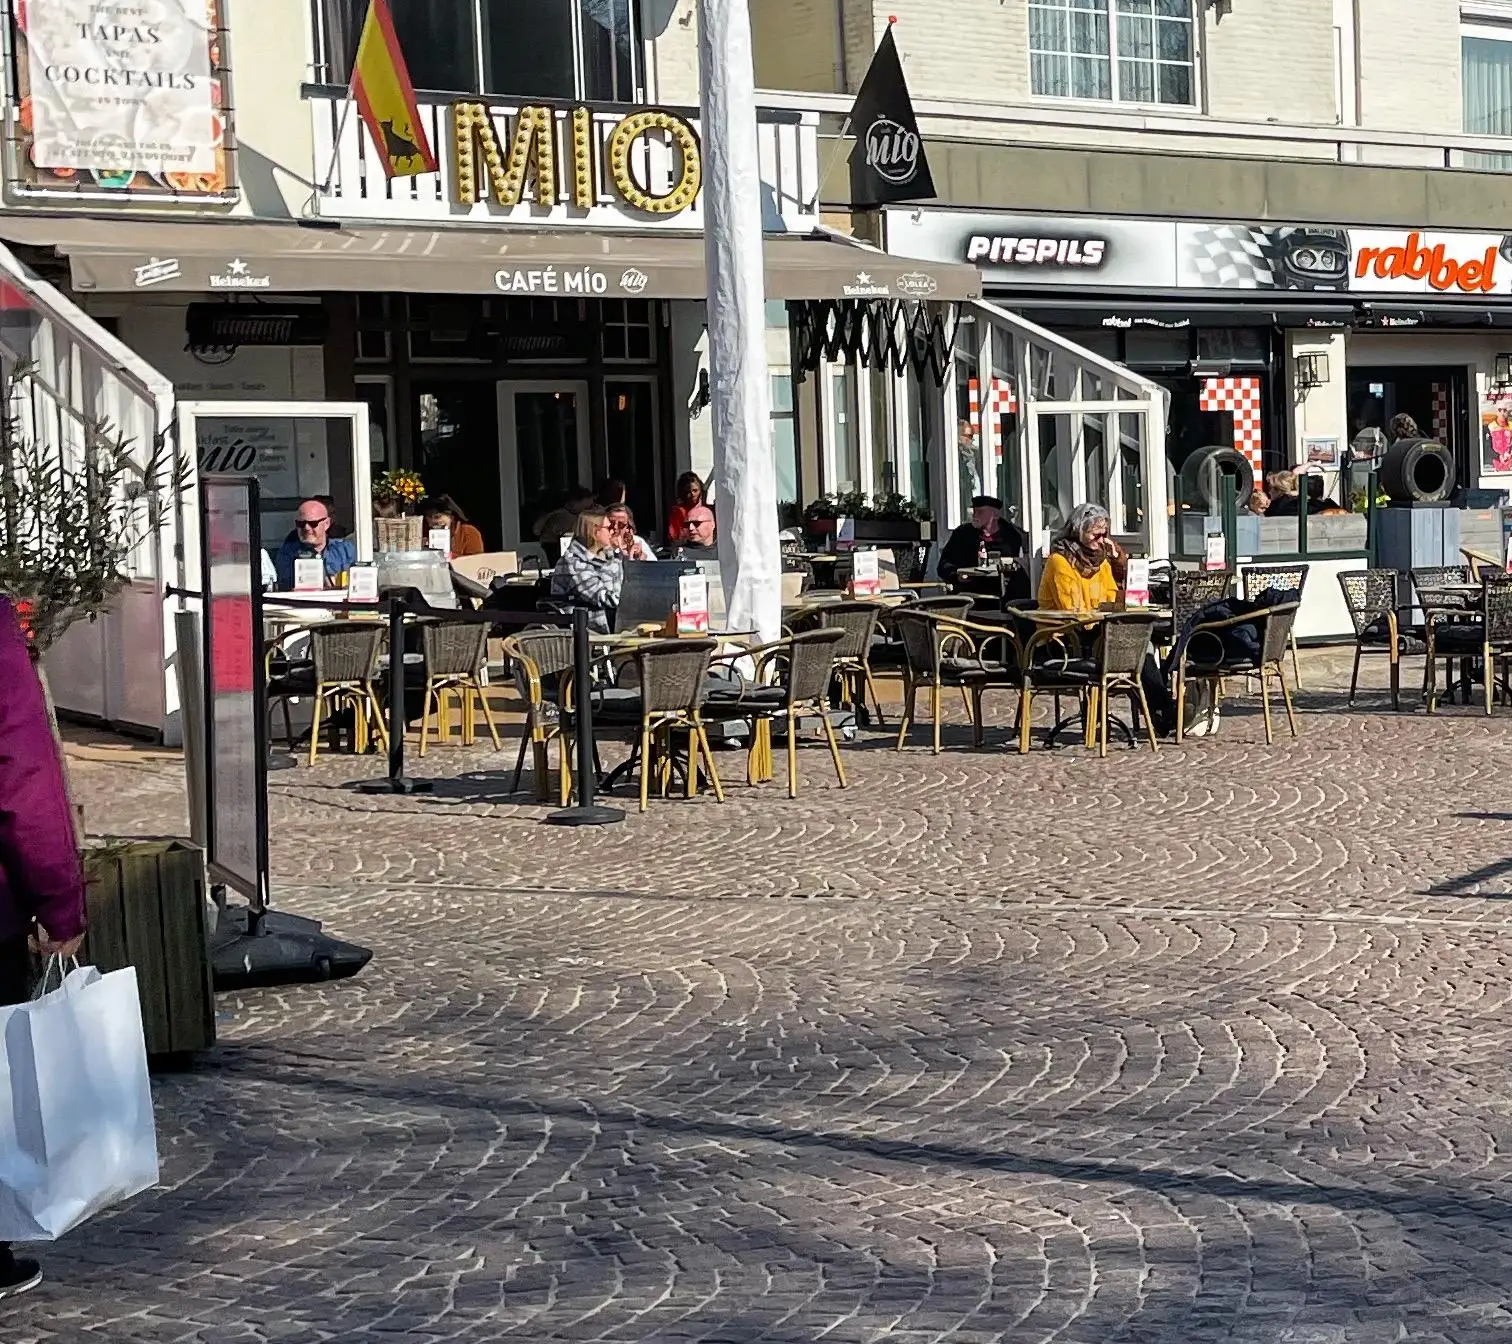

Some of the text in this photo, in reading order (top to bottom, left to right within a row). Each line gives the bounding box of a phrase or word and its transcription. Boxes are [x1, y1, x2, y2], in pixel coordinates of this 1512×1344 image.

[75, 22, 161, 44] TAPAS
[45, 65, 196, 90] COCKTAILS
[967, 236, 1105, 265] PITSPILS
[1355, 232, 1498, 294] rabbel
[494, 265, 608, 294] CAFÉ MÍO
